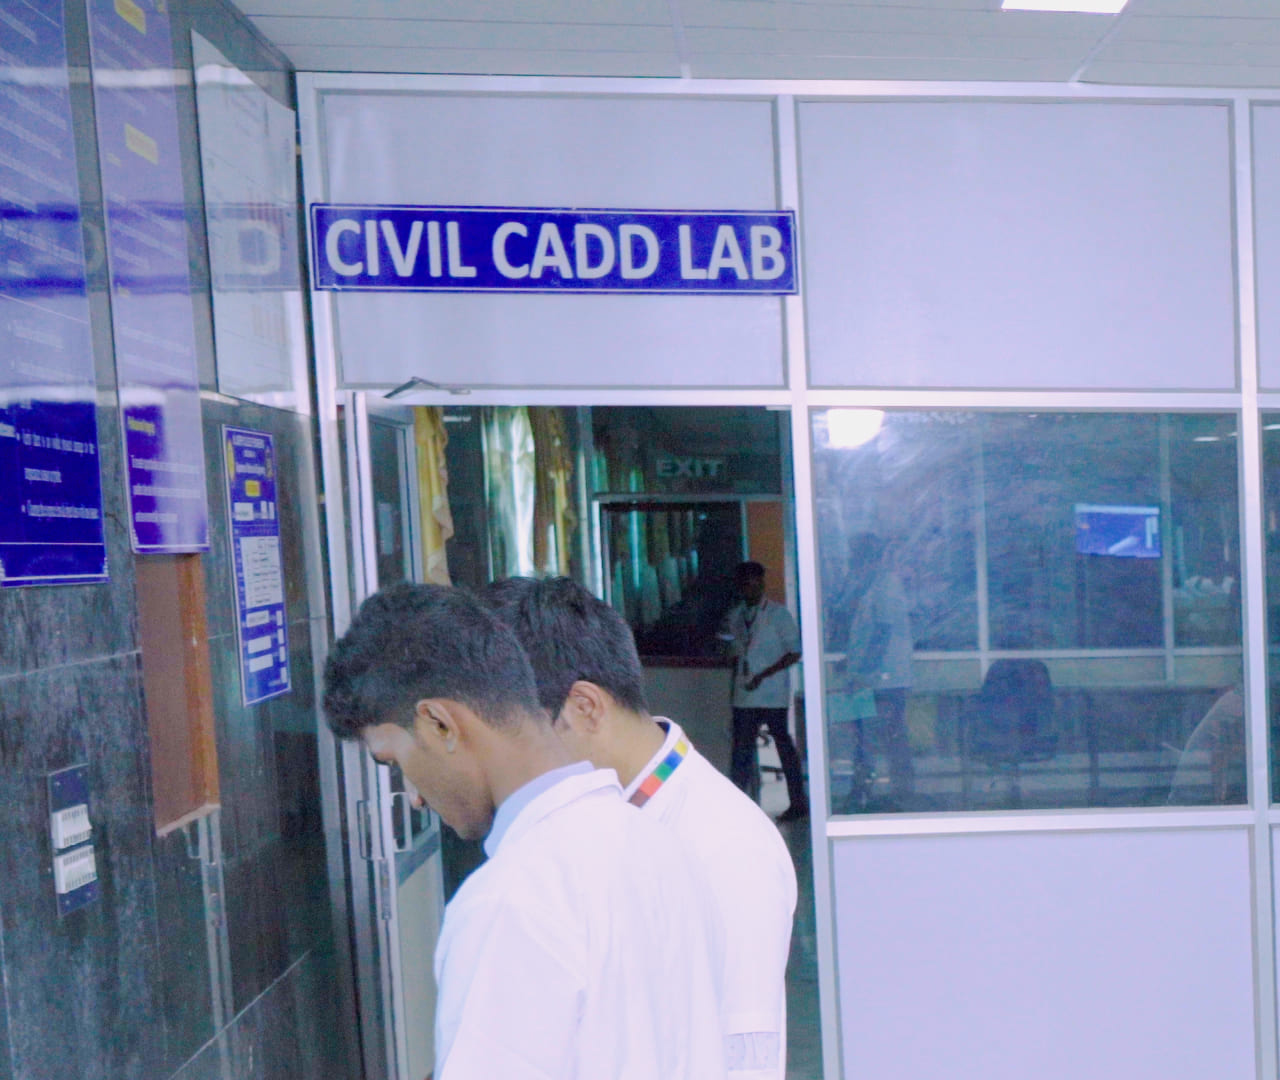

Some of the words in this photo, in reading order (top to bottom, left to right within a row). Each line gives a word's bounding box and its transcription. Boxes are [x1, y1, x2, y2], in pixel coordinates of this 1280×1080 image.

[325, 219, 478, 278] CIVIL
[491, 221, 660, 280] CADD
[678, 224, 786, 280] LAB
[655, 459, 723, 478] EXIT
